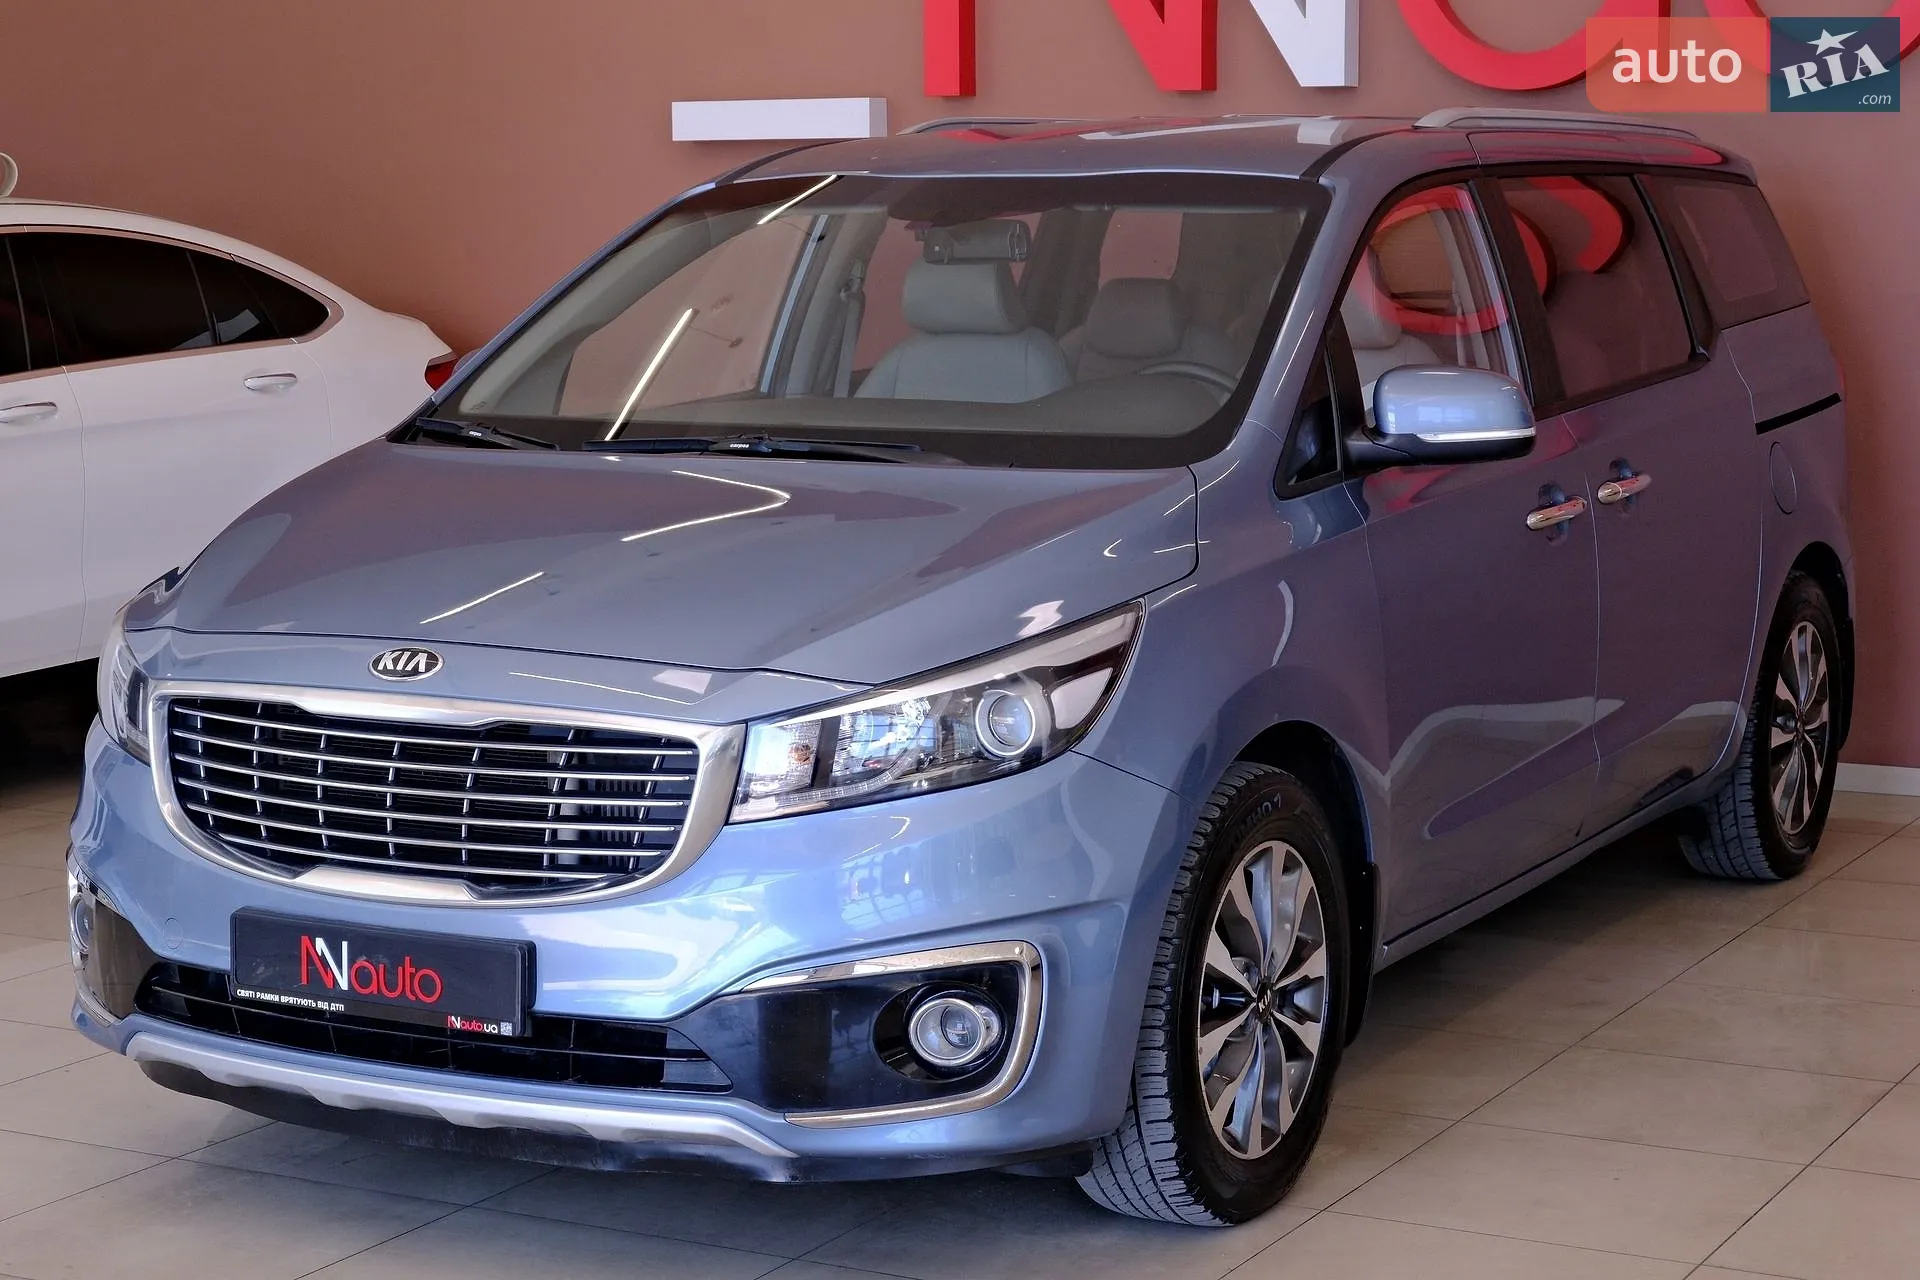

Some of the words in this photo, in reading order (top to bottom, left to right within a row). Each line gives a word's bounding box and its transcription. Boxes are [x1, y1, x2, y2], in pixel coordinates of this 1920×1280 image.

[377, 651, 428, 673] KIA
[300, 935, 443, 1003] NNauto
[236, 989, 255, 998] СВЯТІ
[256, 992, 280, 1002] РАМКИ
[280, 995, 316, 1007] ВРЯТУЮТЬ
[317, 1000, 329, 1011] ВІД
[330, 1003, 345, 1012] ДТП
